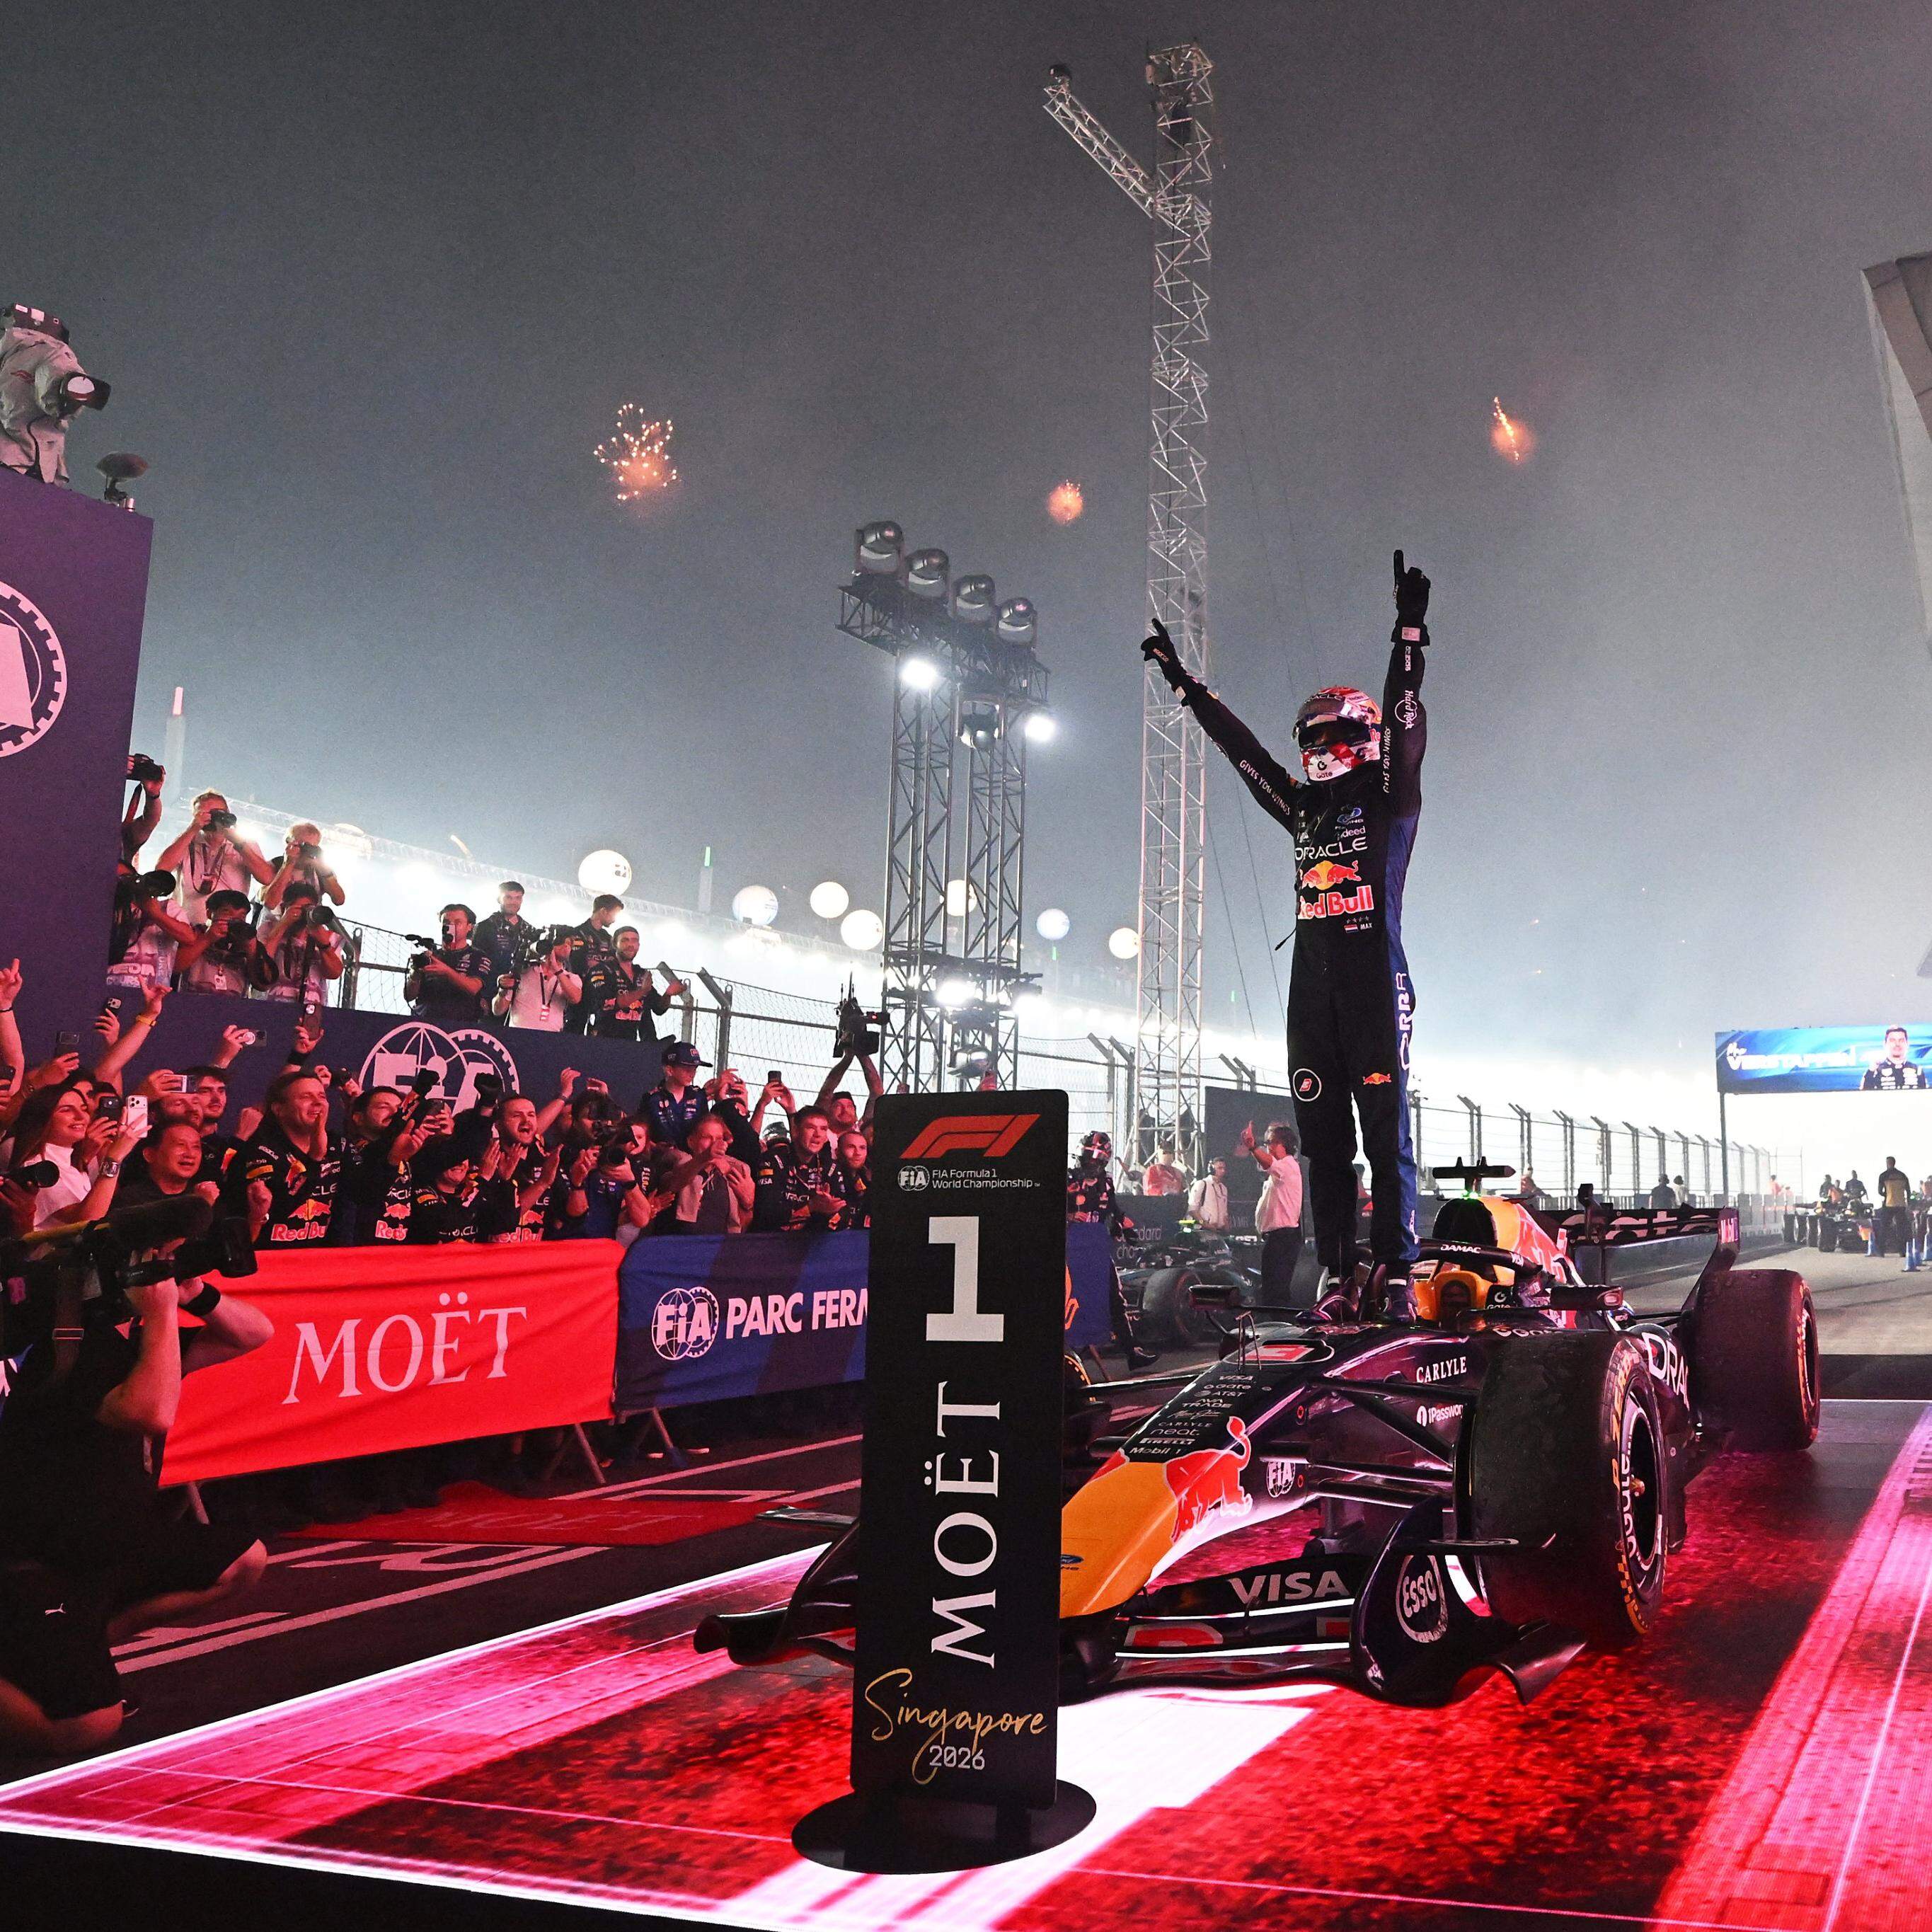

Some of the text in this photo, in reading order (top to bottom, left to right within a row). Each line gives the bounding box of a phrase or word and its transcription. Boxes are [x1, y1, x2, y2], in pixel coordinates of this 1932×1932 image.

[1403, 690, 1415, 730] Hard Rock
[1369, 728, 1381, 743] Re
[1239, 759, 1258, 781] GIVES
[1258, 777, 1272, 793] YOU
[1316, 771, 1333, 779] Gate
[1294, 836, 1368, 861] ORACLE
[1327, 885, 1374, 916] Bull
[899, 1114, 1041, 1159] F1
[932, 1168, 997, 1179] FIA Formula 1
[932, 1180, 961, 1189] World
[963, 1178, 1033, 1189] Championship
[270, 1221, 309, 1241] Red
[1440, 1244, 1481, 1254] DAMAC
[926, 1217, 1004, 1342] 1
[726, 1292, 804, 1340] PARC
[281, 1292, 527, 1404] MOËT
[1416, 1356, 1467, 1384] CARLYLE
[1428, 1404, 1464, 1424] 1Passwor
[924, 1381, 1001, 1669] MOËT
[1226, 1570, 1350, 1604] VISA
[864, 1667, 1048, 1785] Singapore
[928, 1745, 985, 1769] 2026
